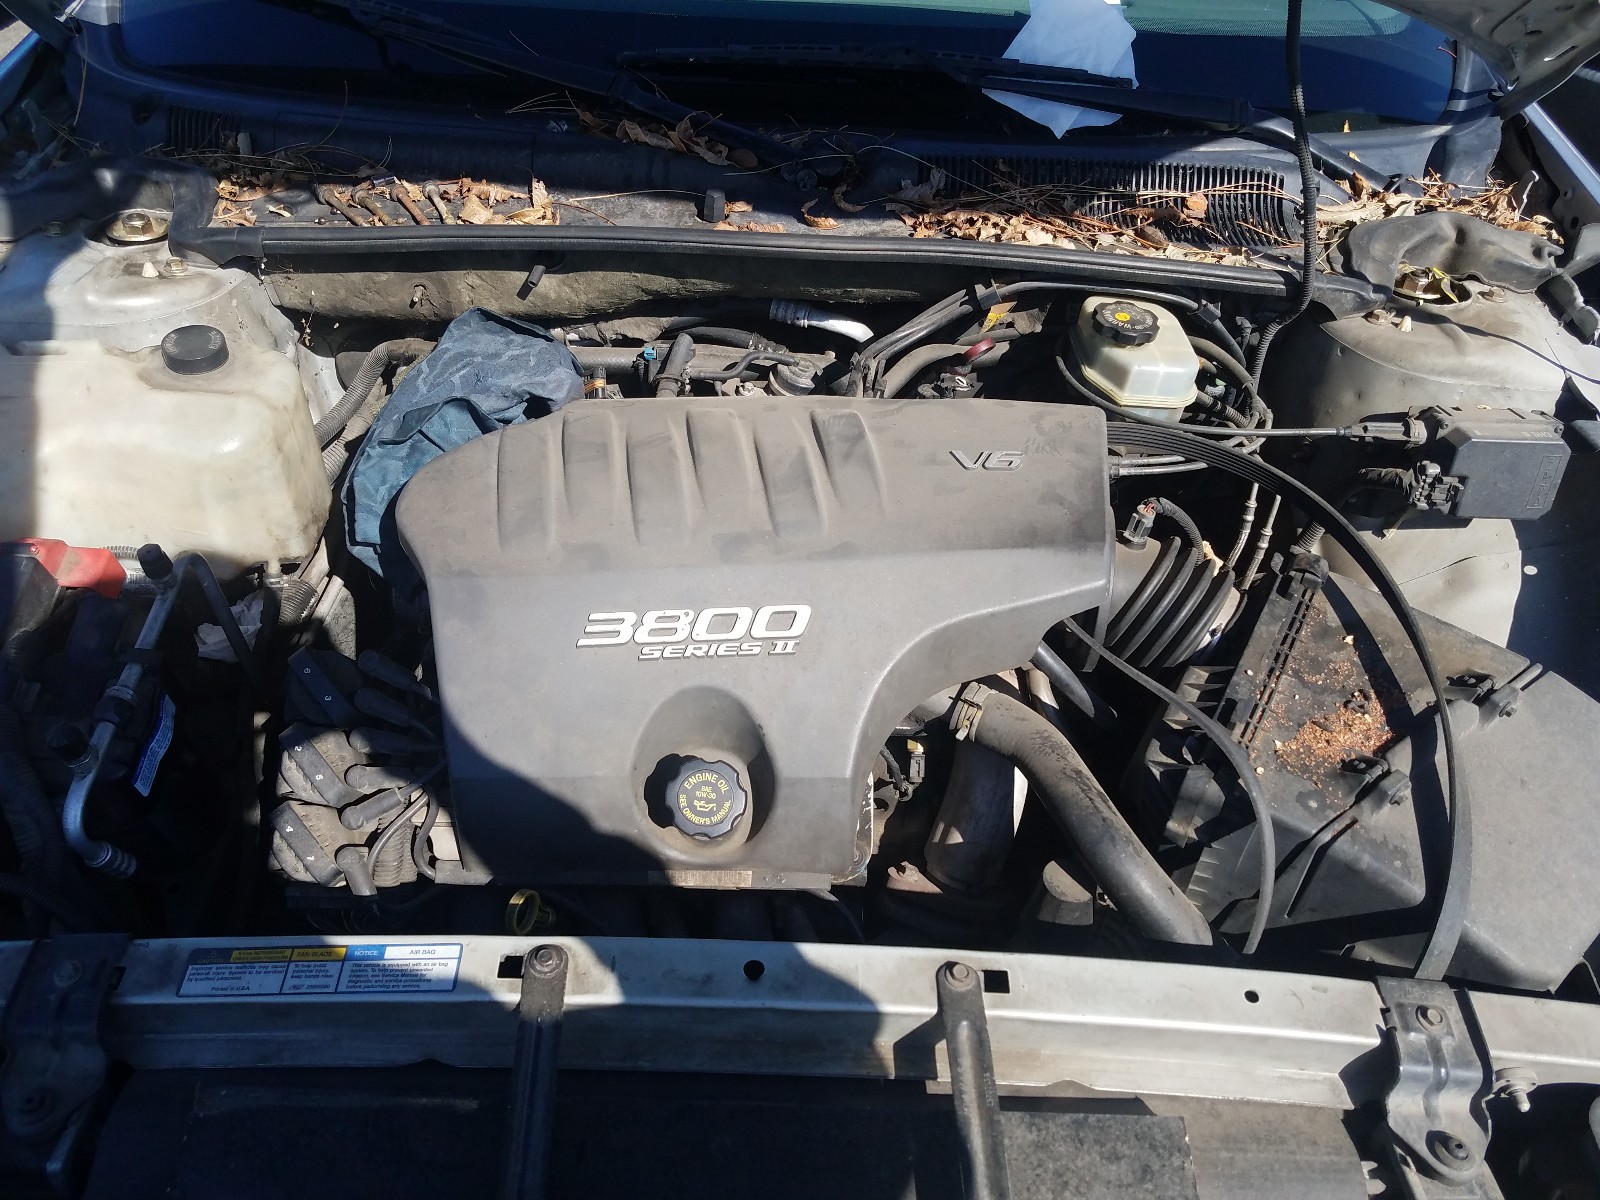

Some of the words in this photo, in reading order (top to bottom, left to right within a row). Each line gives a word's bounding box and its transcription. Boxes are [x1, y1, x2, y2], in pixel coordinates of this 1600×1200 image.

[948, 450, 1024, 471] V6
[576, 604, 812, 648] 3800
[638, 641, 763, 661] SERIES
[768, 640, 800, 656] II
[683, 772, 719, 790] ENGINE
[717, 779, 730, 795] OIL
[679, 794, 688, 808] SEE
[695, 790, 717, 800] 10W-30
[682, 807, 711, 825] OWNER'S
[711, 799, 732, 823] MANUAL
[285, 825, 294, 833] 4
